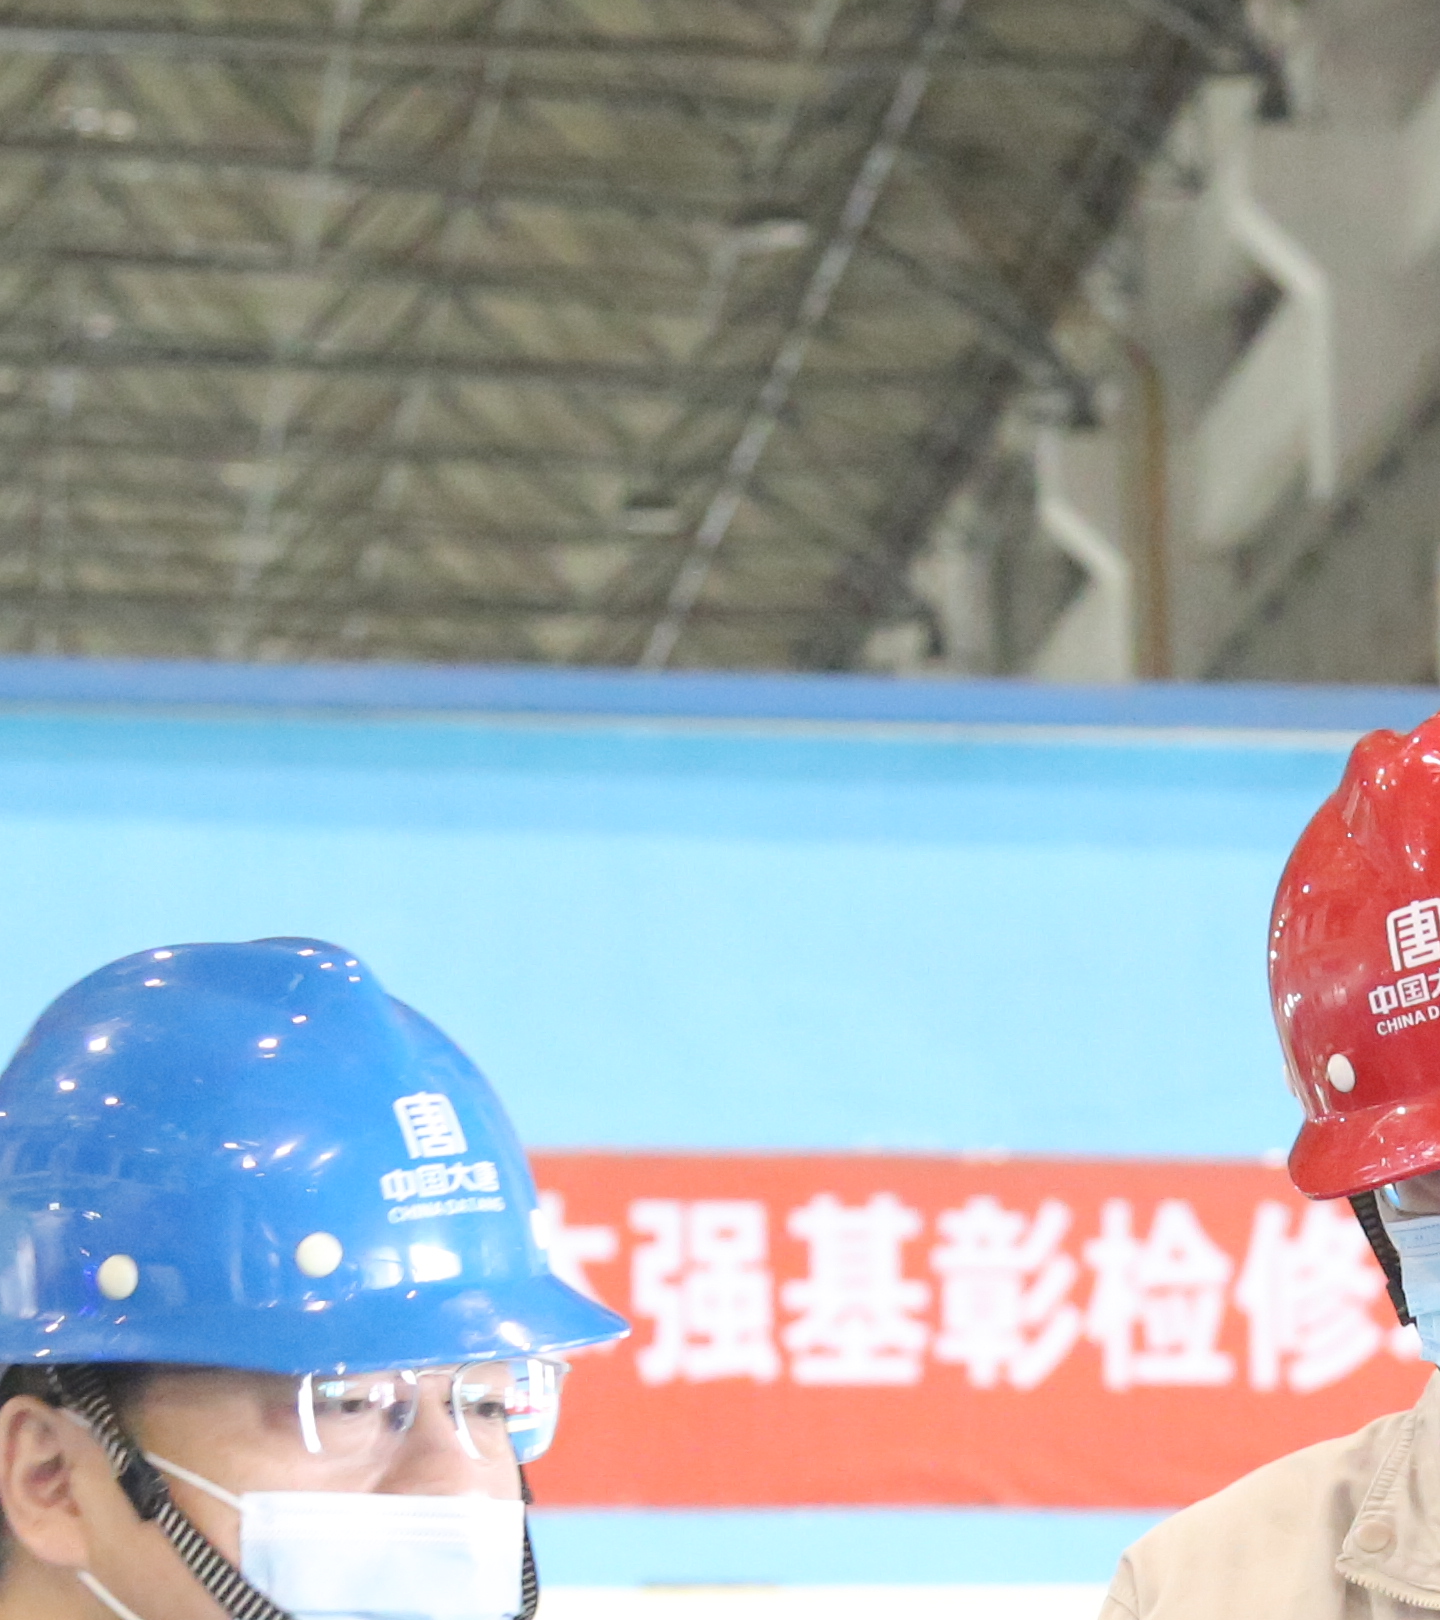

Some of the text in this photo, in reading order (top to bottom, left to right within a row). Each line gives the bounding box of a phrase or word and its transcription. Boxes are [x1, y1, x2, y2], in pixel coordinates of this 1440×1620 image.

[1376, 1010, 1427, 1036] CHINA
[379, 1161, 501, 1202] 中国大唐
[540, 1190, 1422, 1392] 强基彰检修
